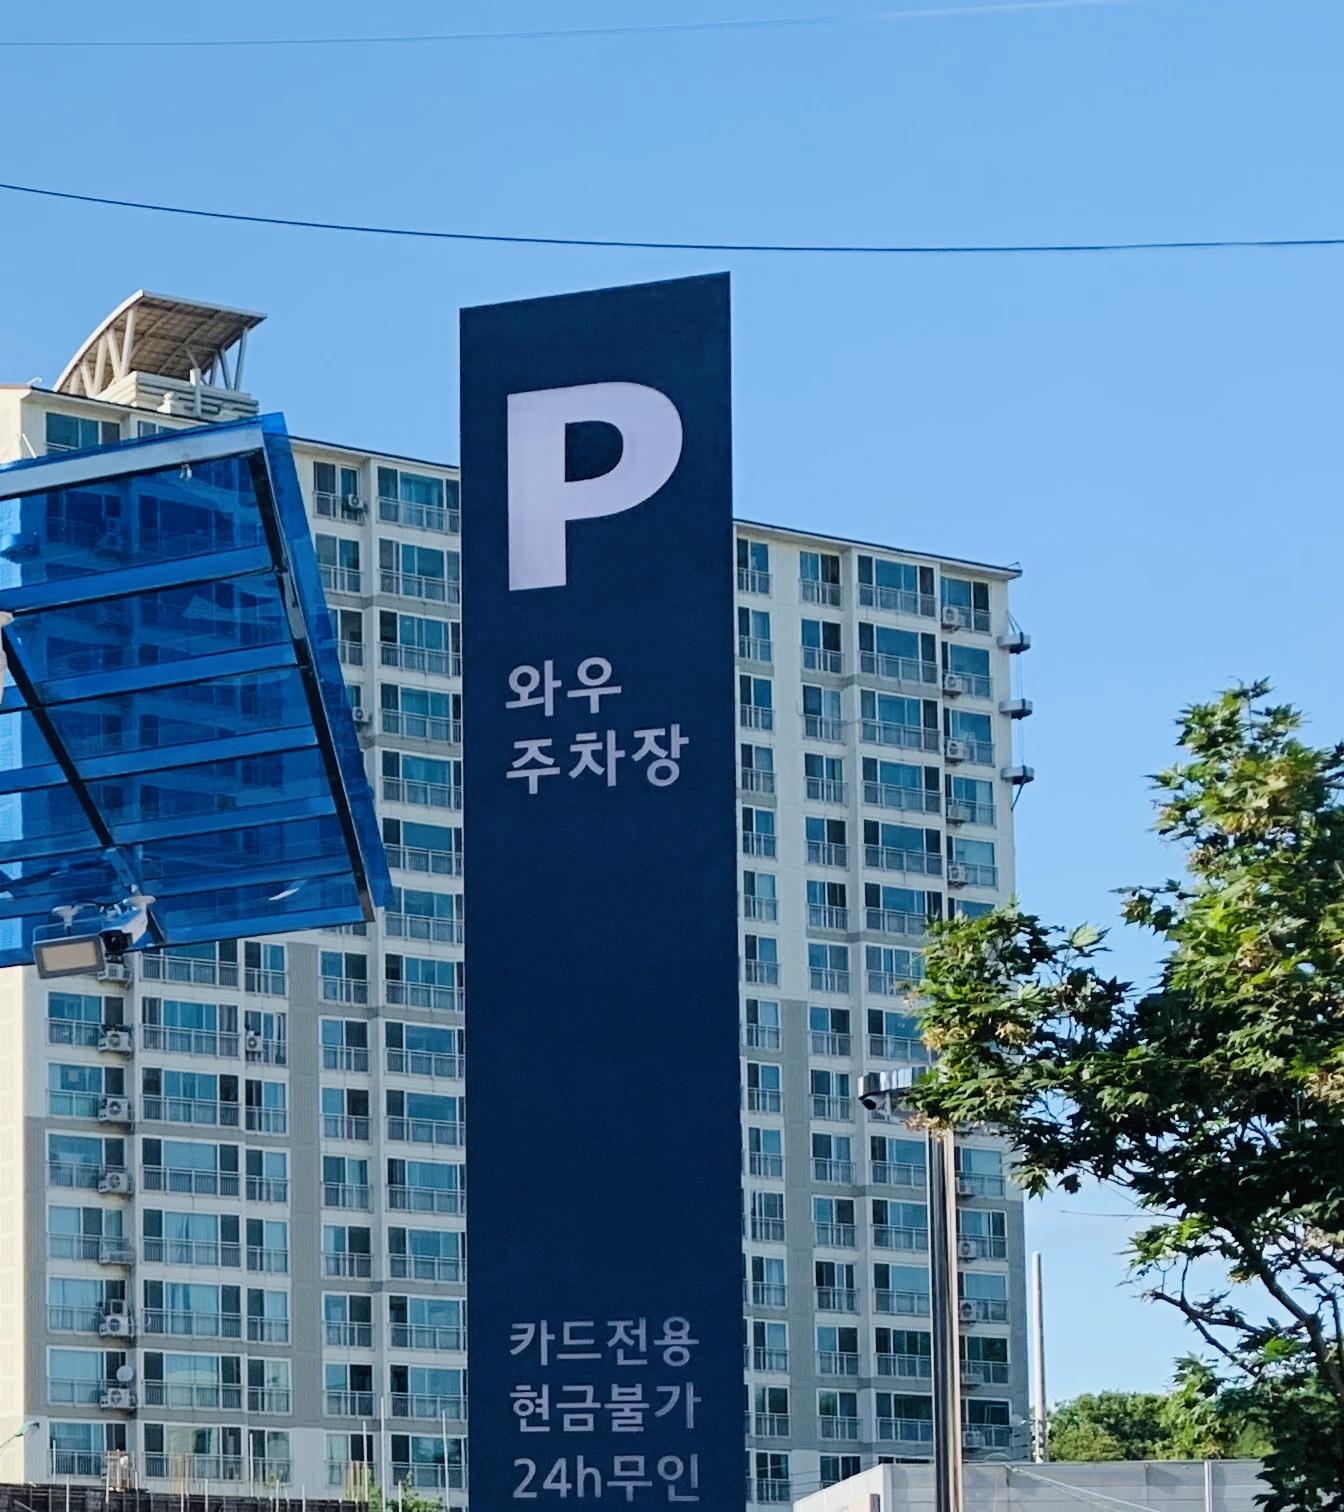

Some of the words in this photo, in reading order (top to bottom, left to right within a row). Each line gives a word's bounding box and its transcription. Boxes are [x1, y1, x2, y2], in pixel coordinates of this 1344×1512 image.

[507, 382, 683, 591] P
[506, 657, 622, 717] 와우
[506, 724, 689, 795] 주차장
[510, 1316, 700, 1367] 카드전용
[510, 1382, 702, 1432] 현금불가
[512, 1453, 700, 1502] 24h무인
